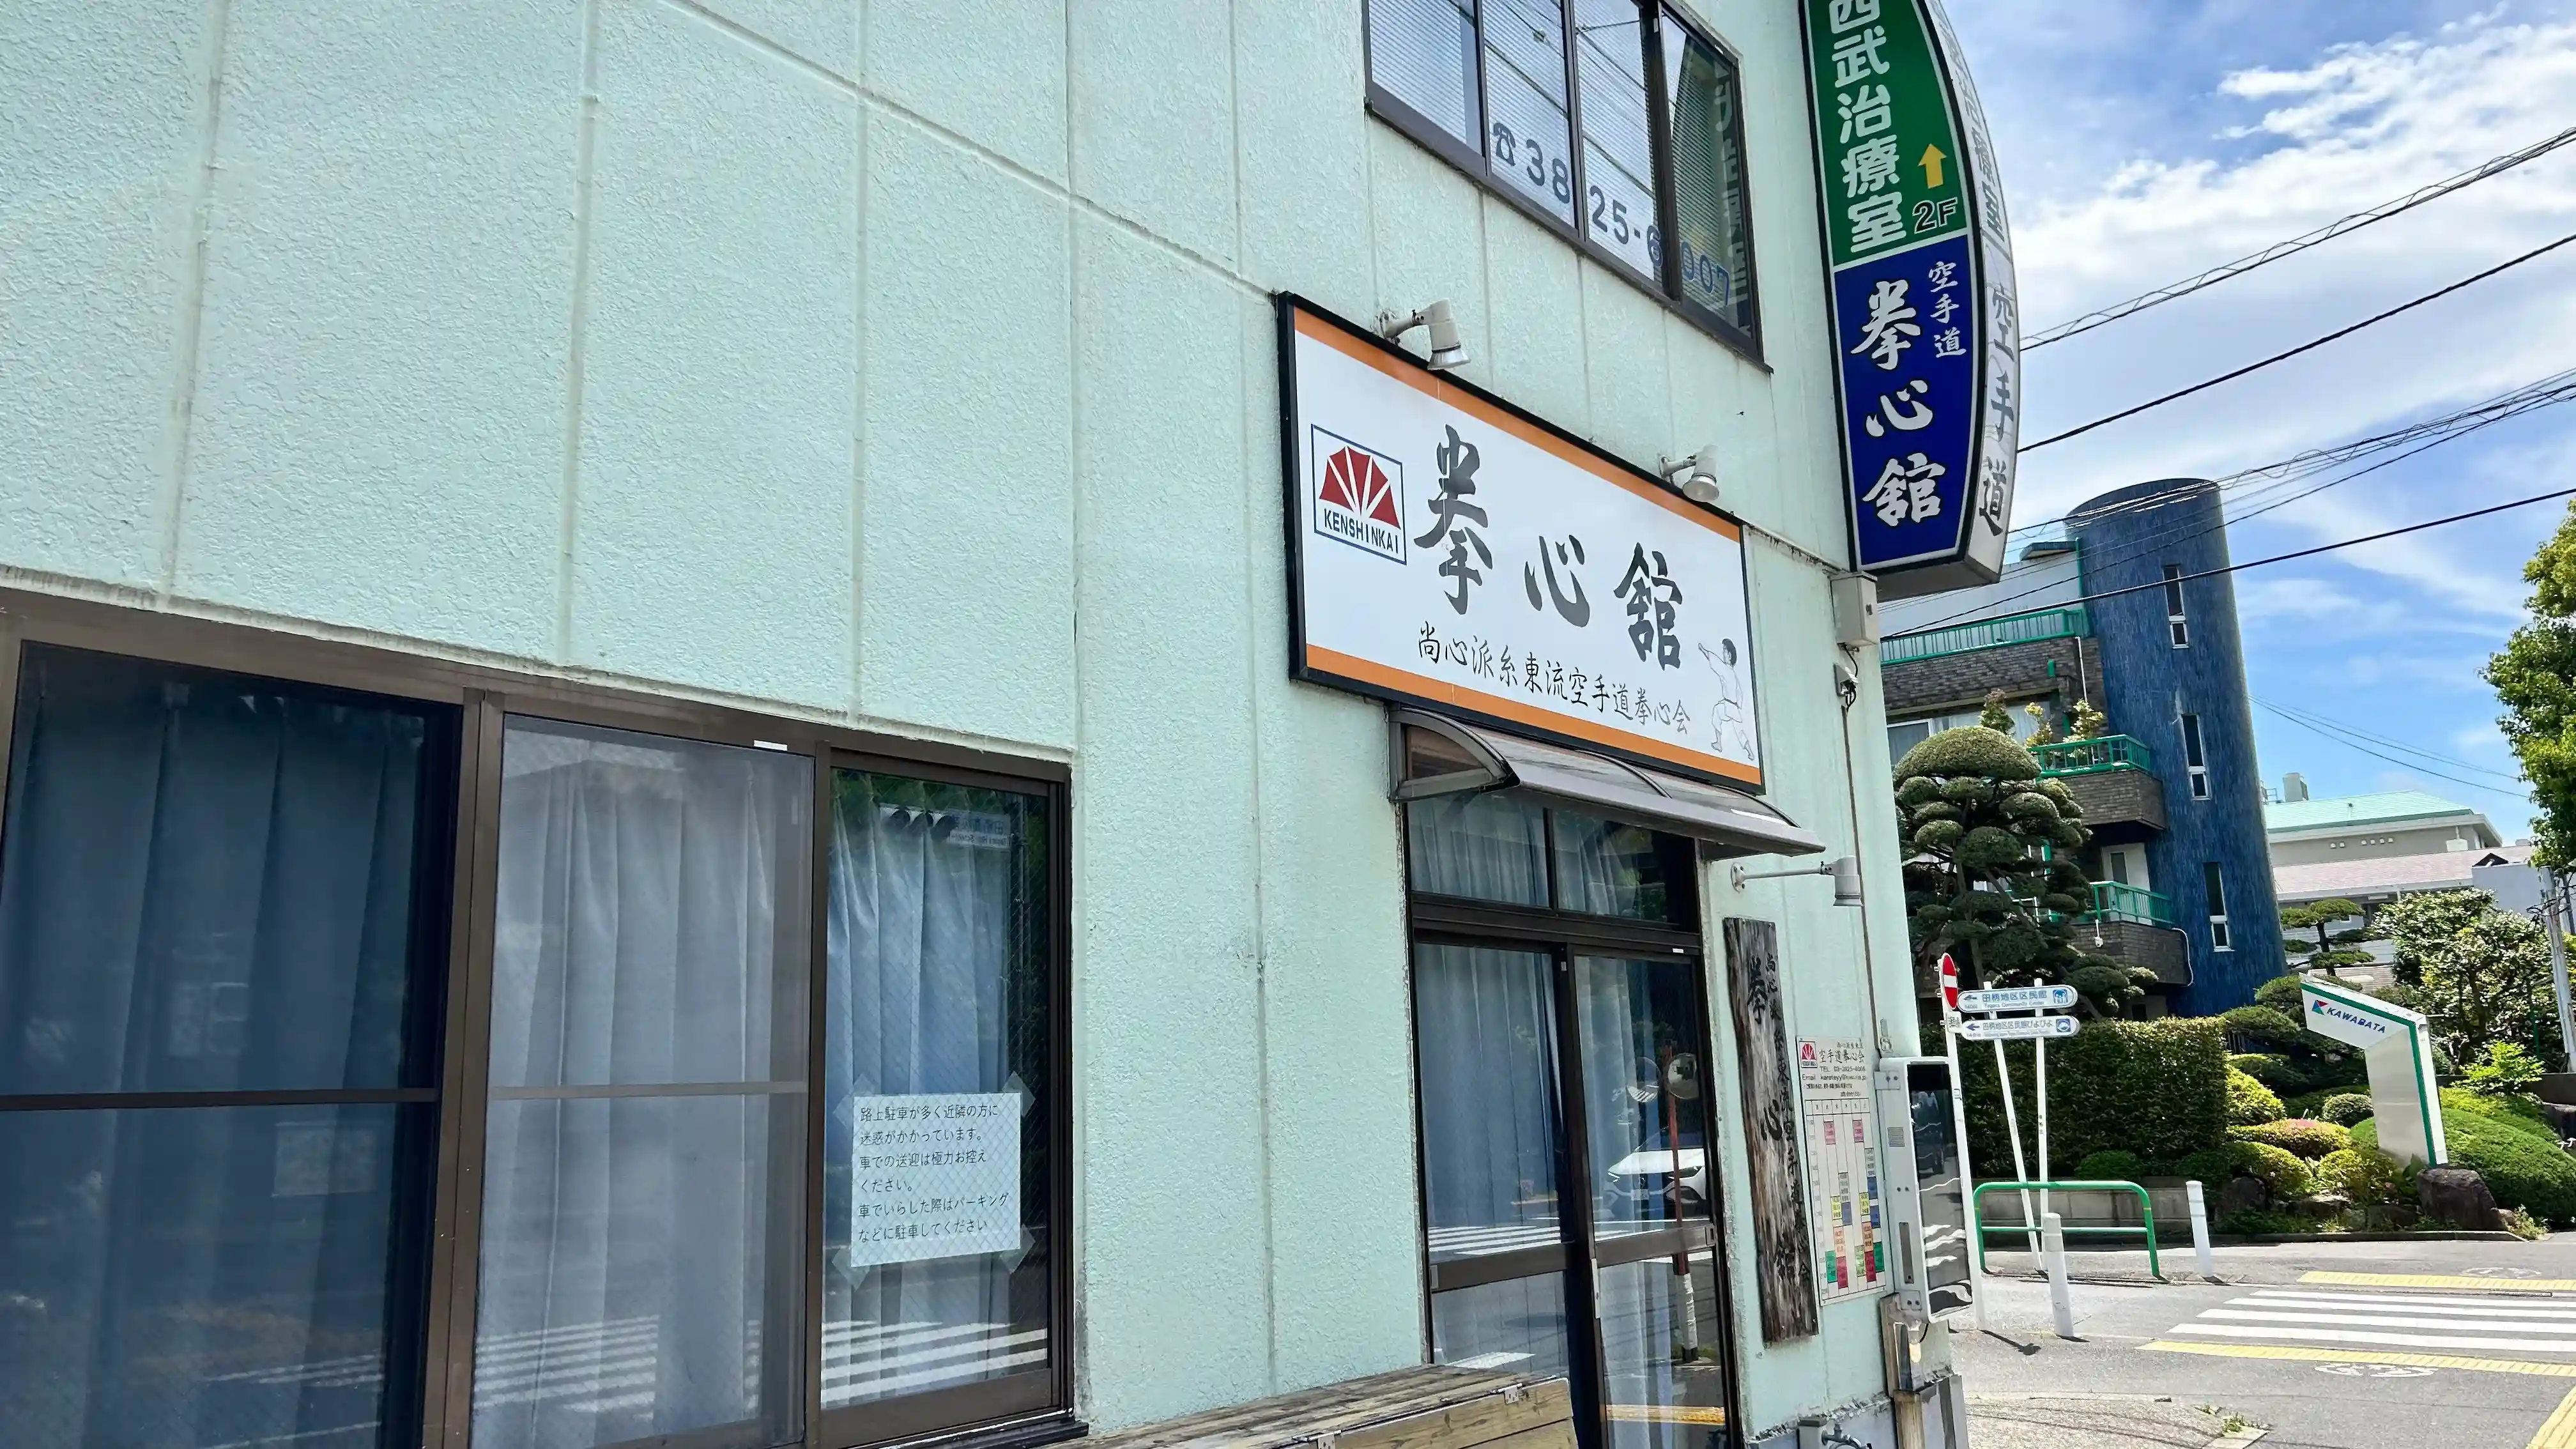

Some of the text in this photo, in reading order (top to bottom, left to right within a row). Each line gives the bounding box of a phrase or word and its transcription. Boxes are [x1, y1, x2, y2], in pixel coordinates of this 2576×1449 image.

[1912, 197, 1958, 234] 2F
[1928, 261, 1966, 358] 空手道
[1979, 285, 2014, 537] 空手道
[1324, 508, 1399, 554] KENSHINKAI
[1418, 620, 1690, 735] 尚心派糸東流空手道拳心会
[2327, 1008, 2386, 1033] KAWABATA
[860, 1104, 999, 1122] 路上駐車が多く近隣の方に
[860, 1126, 982, 1146] 迷惑がかかっています。
[859, 1149, 987, 1169] 車での送迎は極力お控え
[861, 1177, 913, 1193] ください。
[858, 1192, 1009, 1218] 車でいらした際はパーキング
[858, 1218, 988, 1243] などに駐車してください
